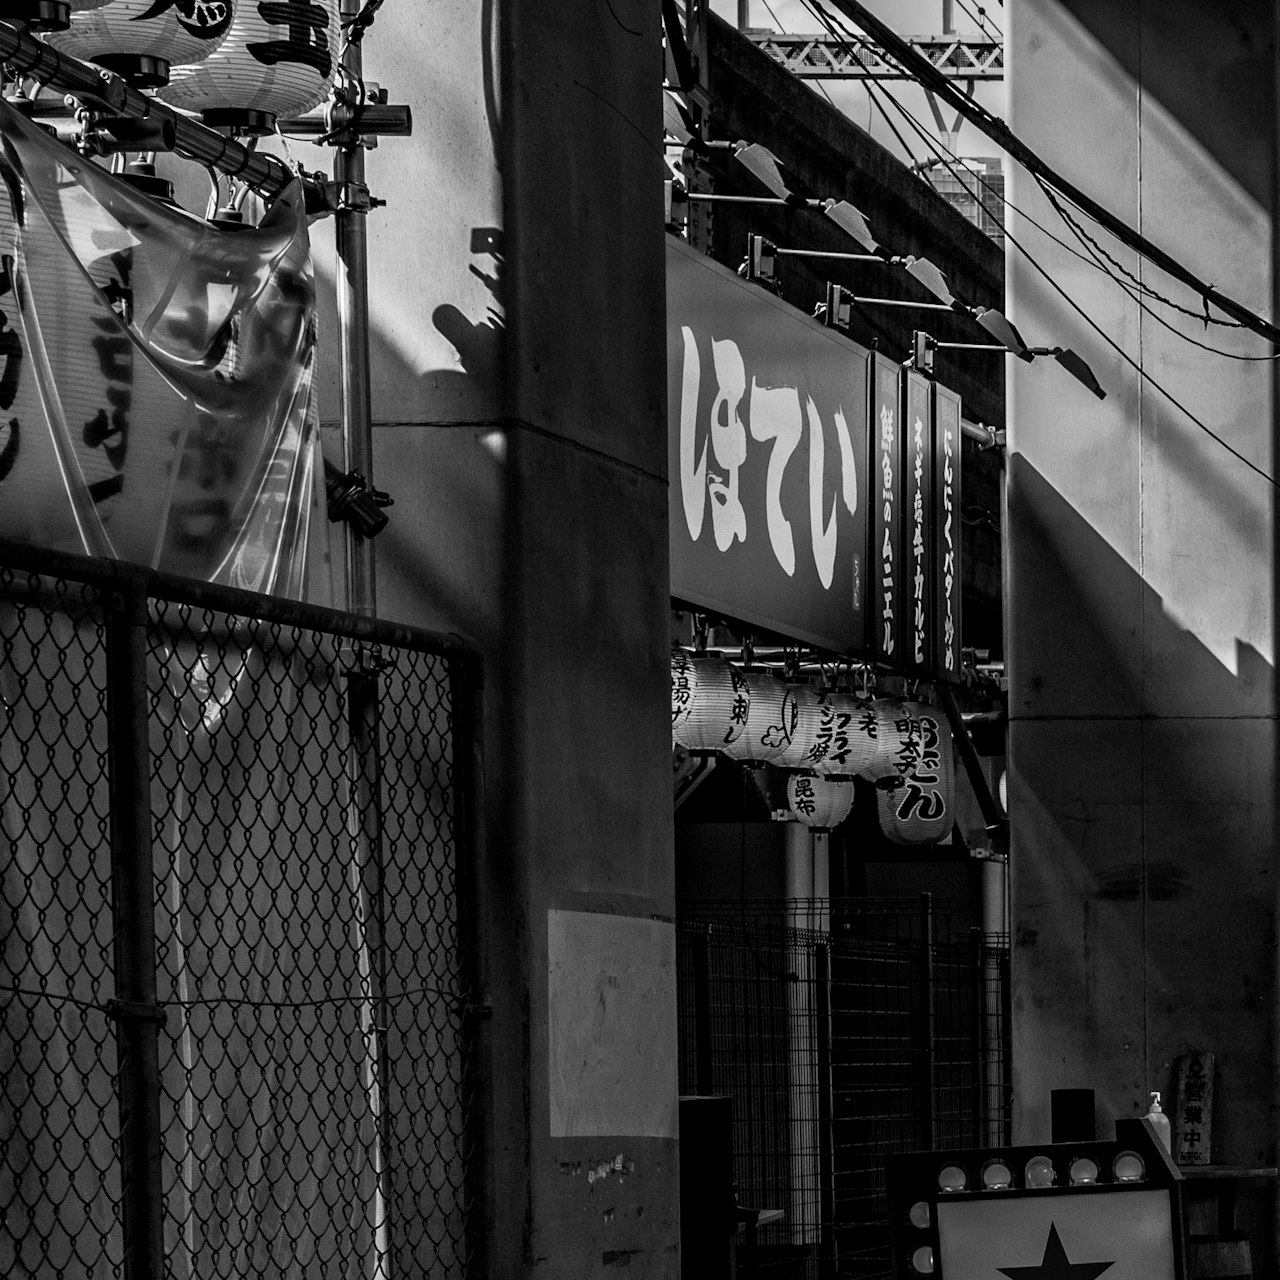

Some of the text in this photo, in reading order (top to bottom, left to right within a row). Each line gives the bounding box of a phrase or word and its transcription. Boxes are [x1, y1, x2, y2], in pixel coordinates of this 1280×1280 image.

[680, 326, 857, 590] ほてい
[880, 404, 894, 656] 鮮魚のムニエル
[913, 416, 925, 664] ネギ塩牛カルビ
[892, 719, 922, 774] 明太子
[1184, 1074, 1205, 1147] 営業中
